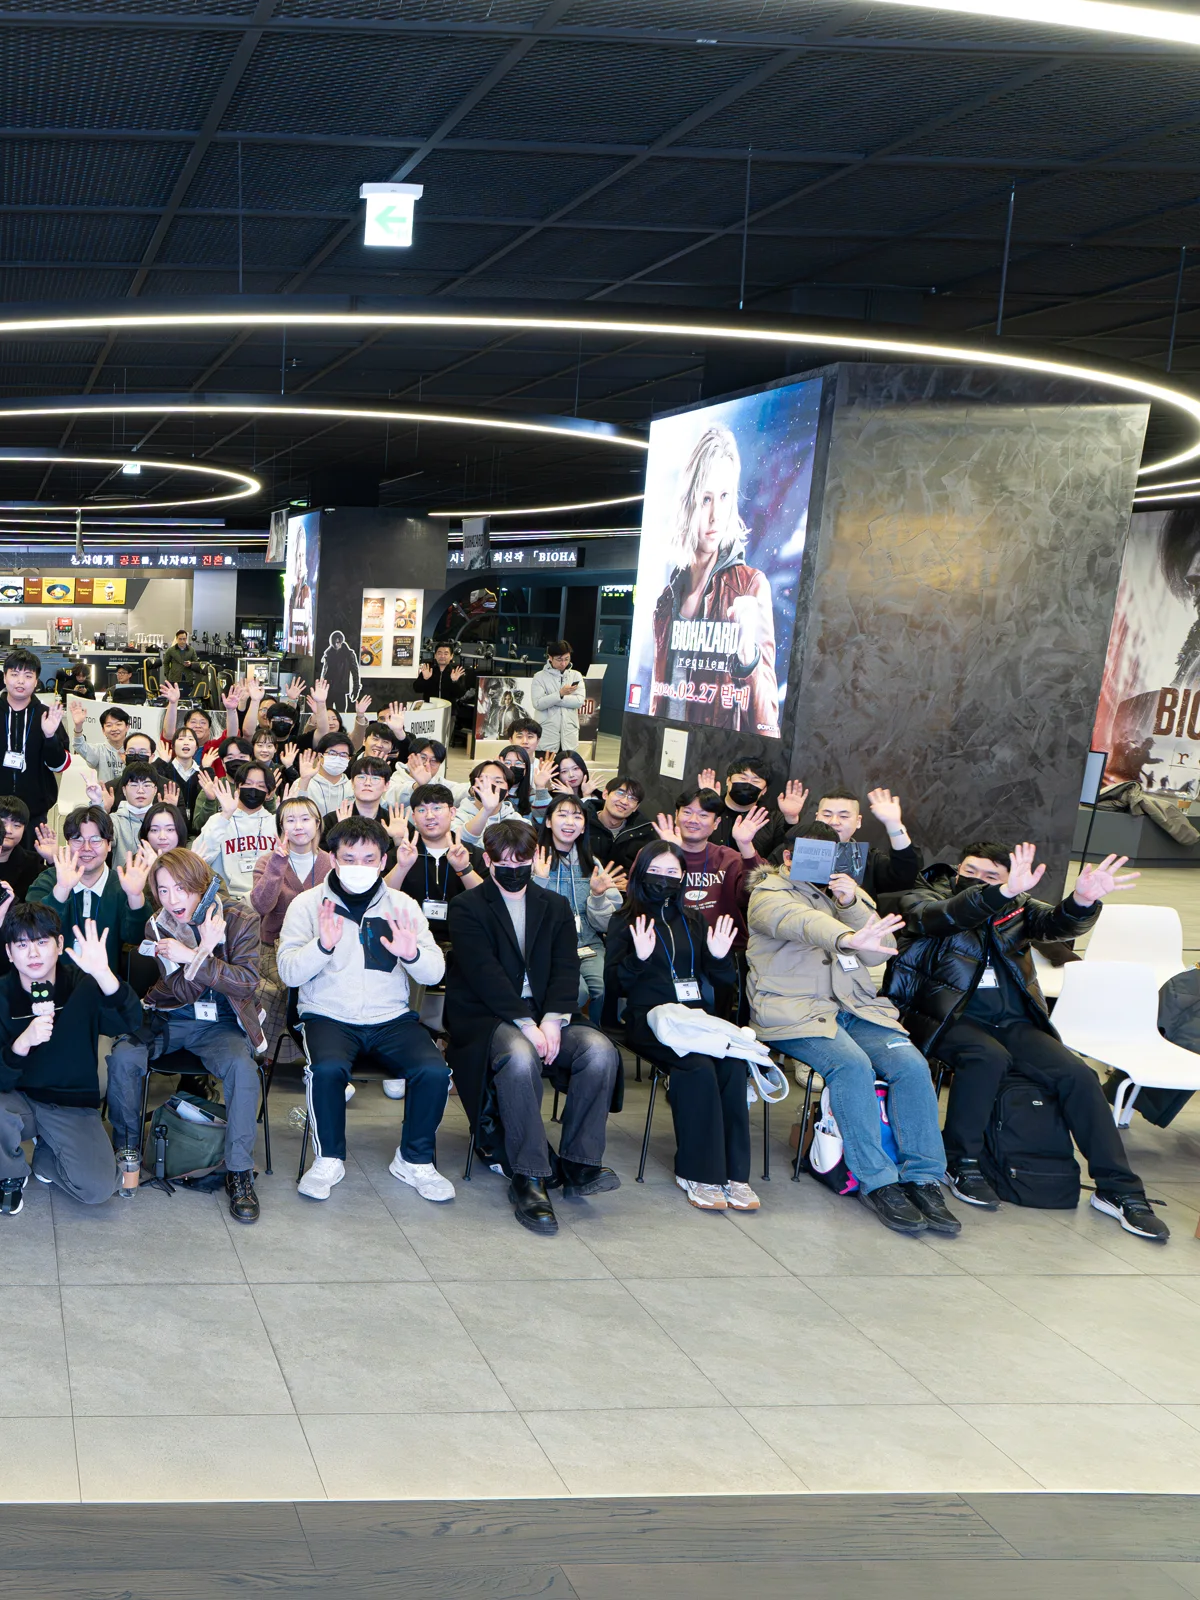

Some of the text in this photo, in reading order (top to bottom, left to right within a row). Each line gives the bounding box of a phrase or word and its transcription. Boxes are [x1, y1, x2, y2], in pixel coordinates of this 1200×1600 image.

[158, 555, 197, 566] 사자에게
[493, 552, 524, 563] 최신작
[671, 620, 740, 654] BIOHAZARD
[653, 681, 750, 710] 2026.02.27 발매
[225, 835, 277, 855] NERDY
